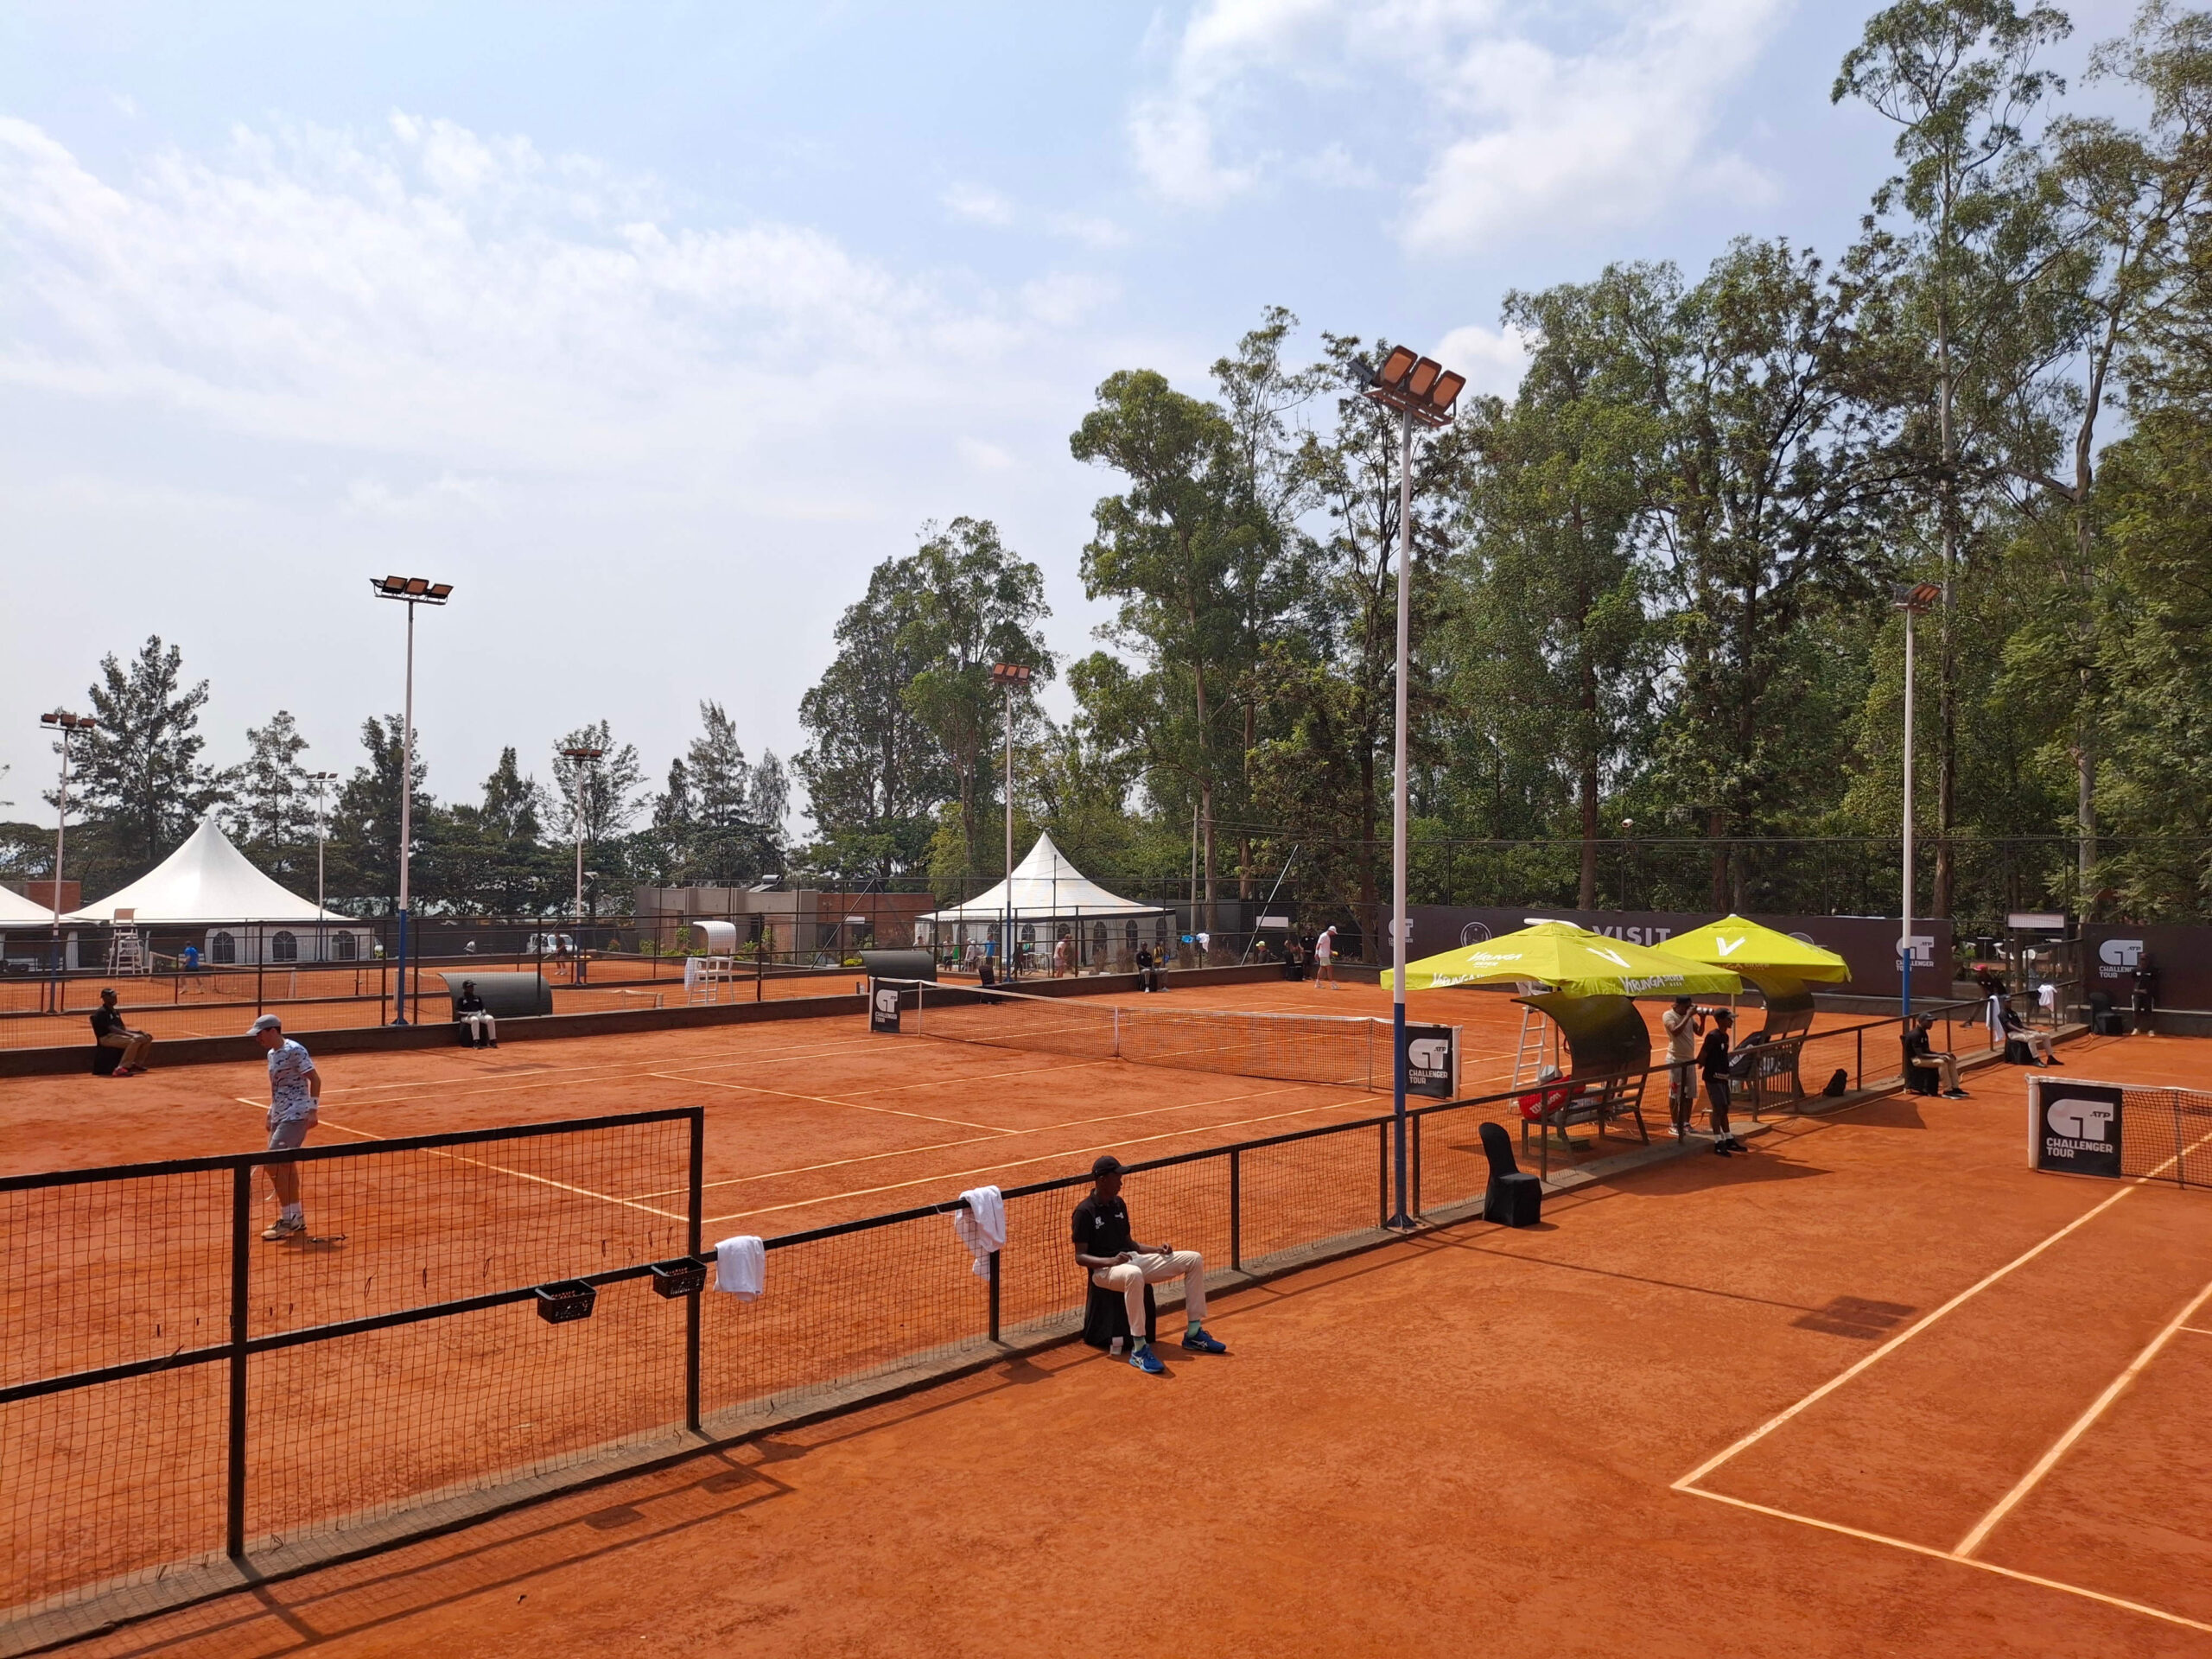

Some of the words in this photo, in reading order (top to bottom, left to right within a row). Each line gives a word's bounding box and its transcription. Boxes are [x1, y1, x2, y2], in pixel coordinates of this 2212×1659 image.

[1592, 925, 1670, 946] VISIT
[1618, 975, 1666, 995] VIRUNGA
[1408, 1069, 1448, 1078] CHALLENGER
[1409, 1076, 1427, 1084] TOUR
[2046, 1137, 2113, 1154] CHALLENGER
[2046, 1147, 2075, 1159] TOUR
